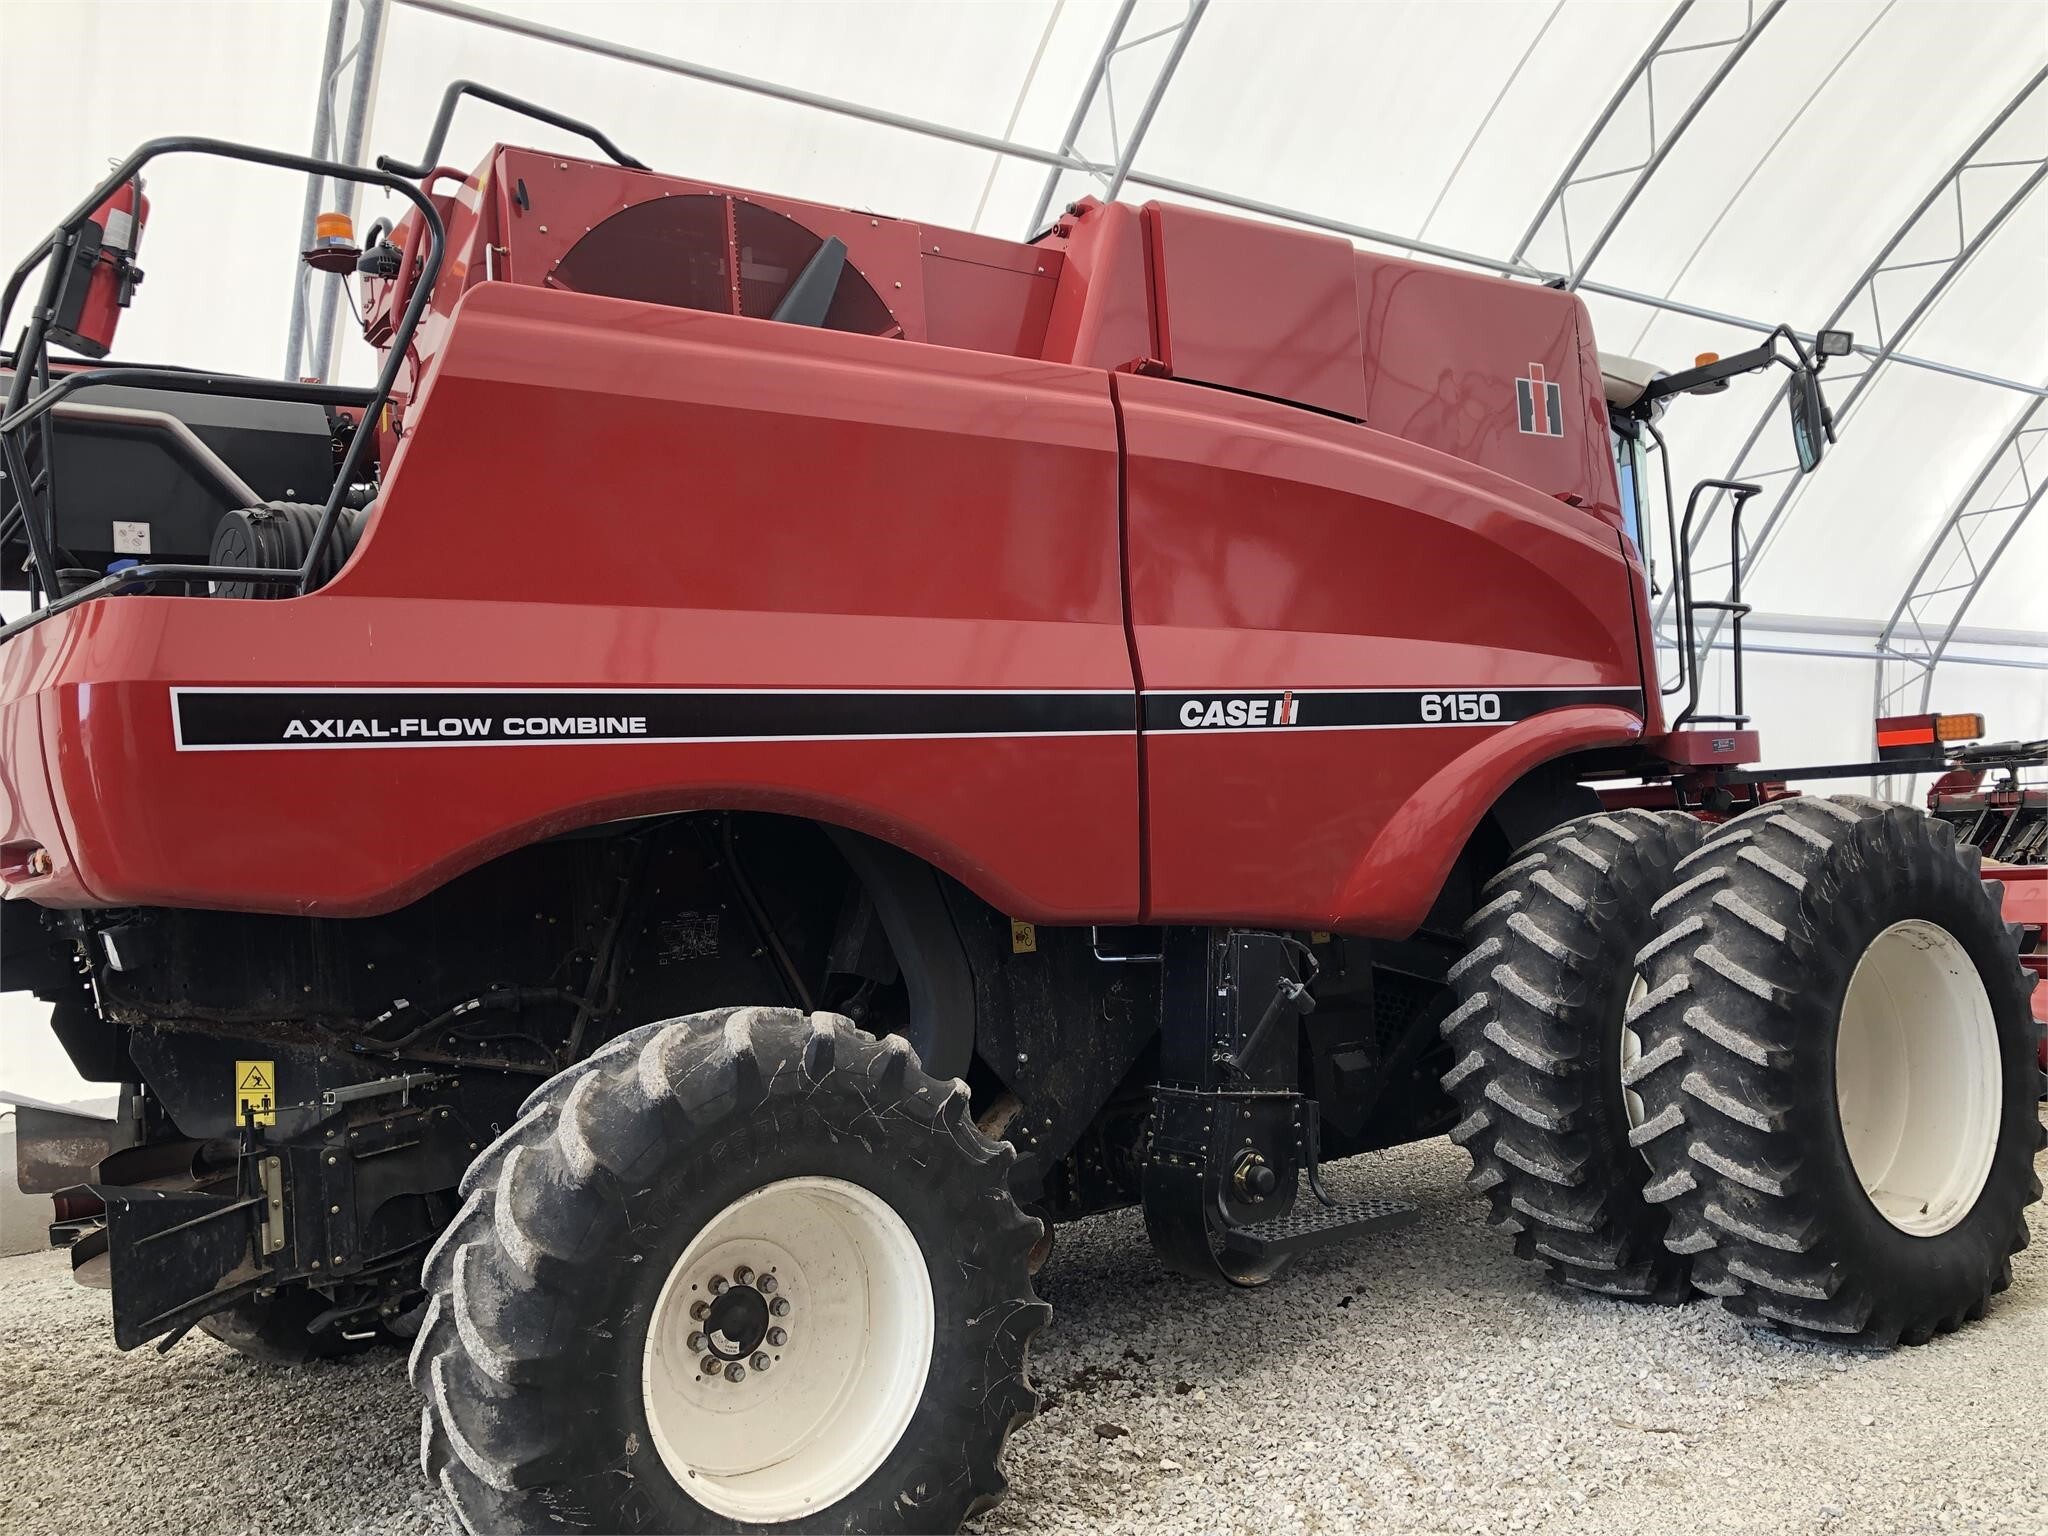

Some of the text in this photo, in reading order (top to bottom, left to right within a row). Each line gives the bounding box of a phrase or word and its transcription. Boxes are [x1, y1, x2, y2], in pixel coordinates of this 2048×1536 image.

[1179, 700, 1269, 727] CASE
[1420, 693, 1500, 722] 6150
[282, 716, 647, 738] AXIAL-FLOW COMBINE
